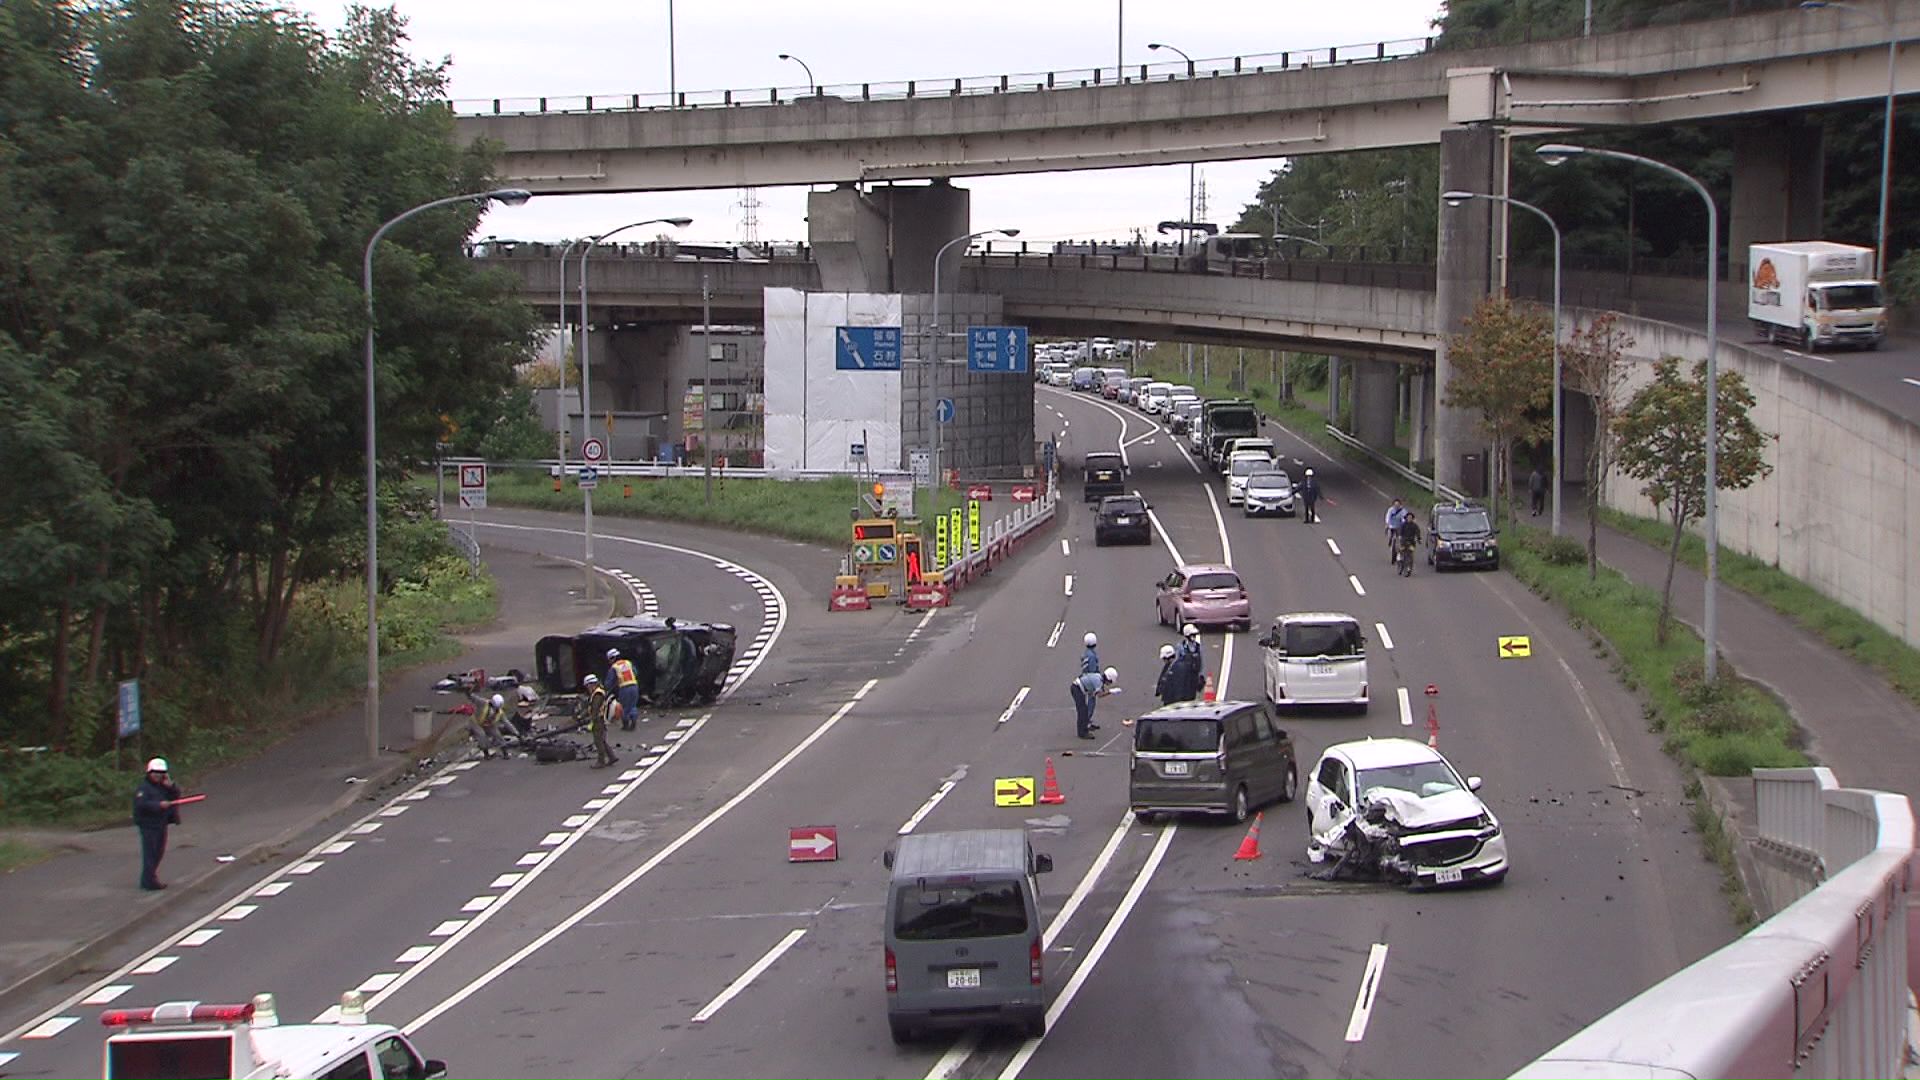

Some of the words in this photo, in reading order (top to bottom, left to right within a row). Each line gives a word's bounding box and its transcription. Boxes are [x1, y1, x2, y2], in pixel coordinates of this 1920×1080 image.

[975, 331, 997, 341] 札幌
[874, 350, 896, 361] 石狩
[587, 444, 599, 456] 40
